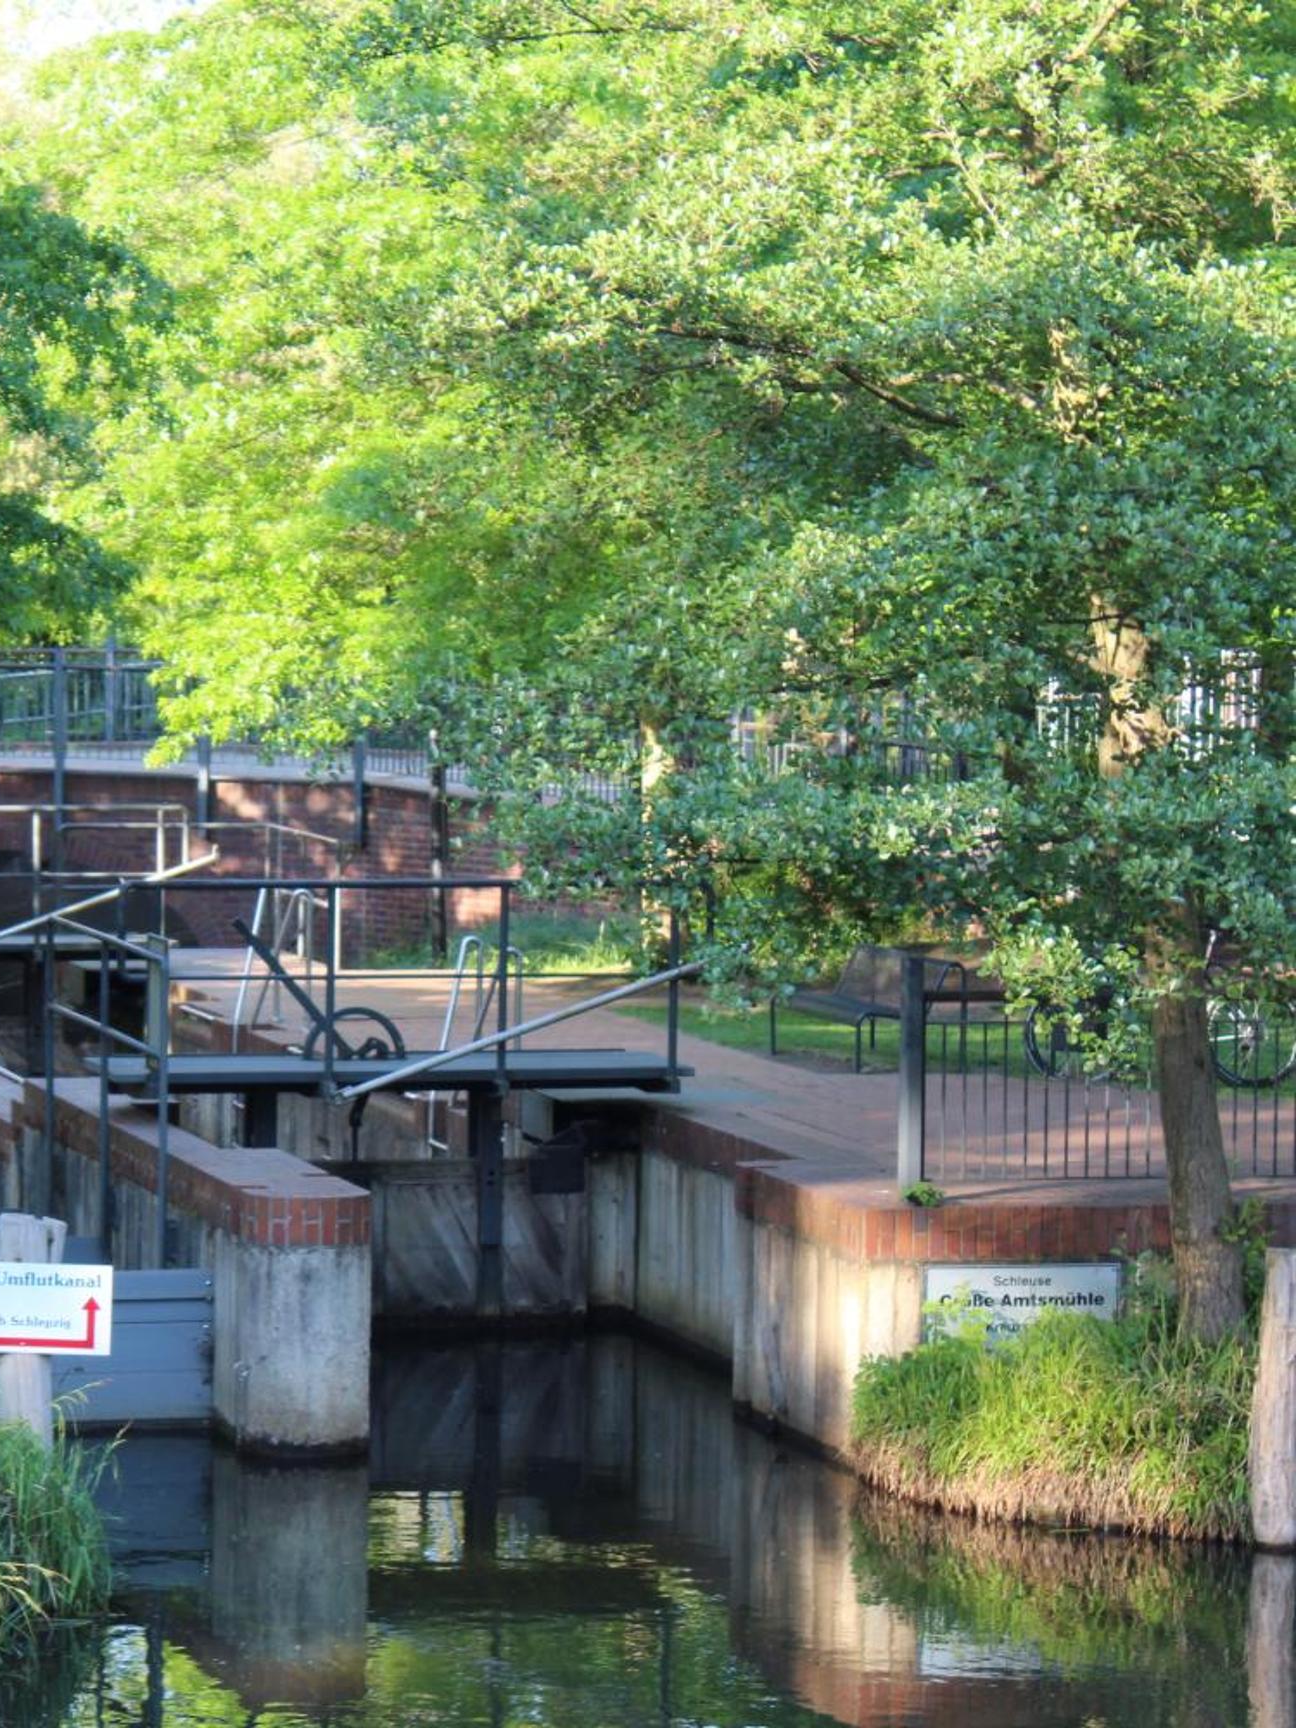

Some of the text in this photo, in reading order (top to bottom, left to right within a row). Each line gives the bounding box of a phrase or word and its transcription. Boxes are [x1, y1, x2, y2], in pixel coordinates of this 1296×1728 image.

[993, 1275, 1052, 1287] Schleuse
[1001, 1292, 1105, 1307] Amtsmühle
[10, 1316, 71, 1329] Schlepzig
